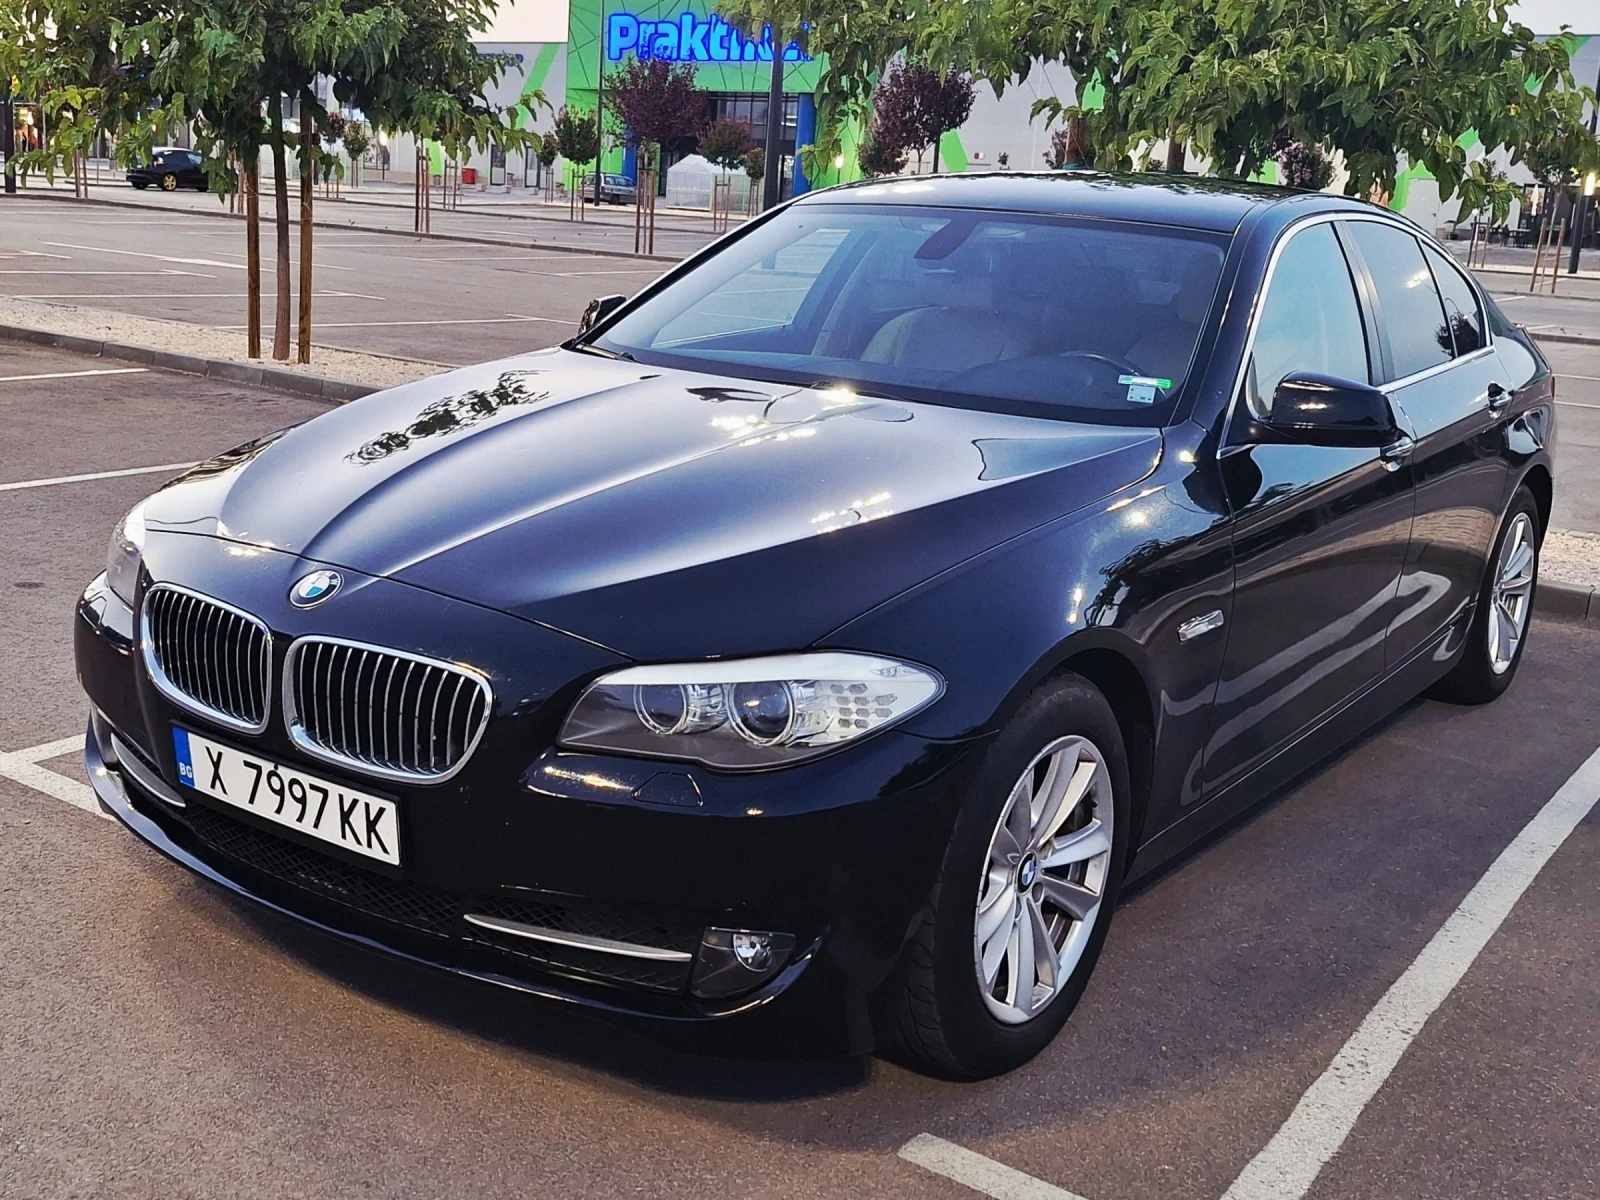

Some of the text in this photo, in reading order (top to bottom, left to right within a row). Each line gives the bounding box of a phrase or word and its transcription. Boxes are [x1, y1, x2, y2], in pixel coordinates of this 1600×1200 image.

[179, 761, 193, 779] BG
[205, 746, 391, 855] X 7997 KK
